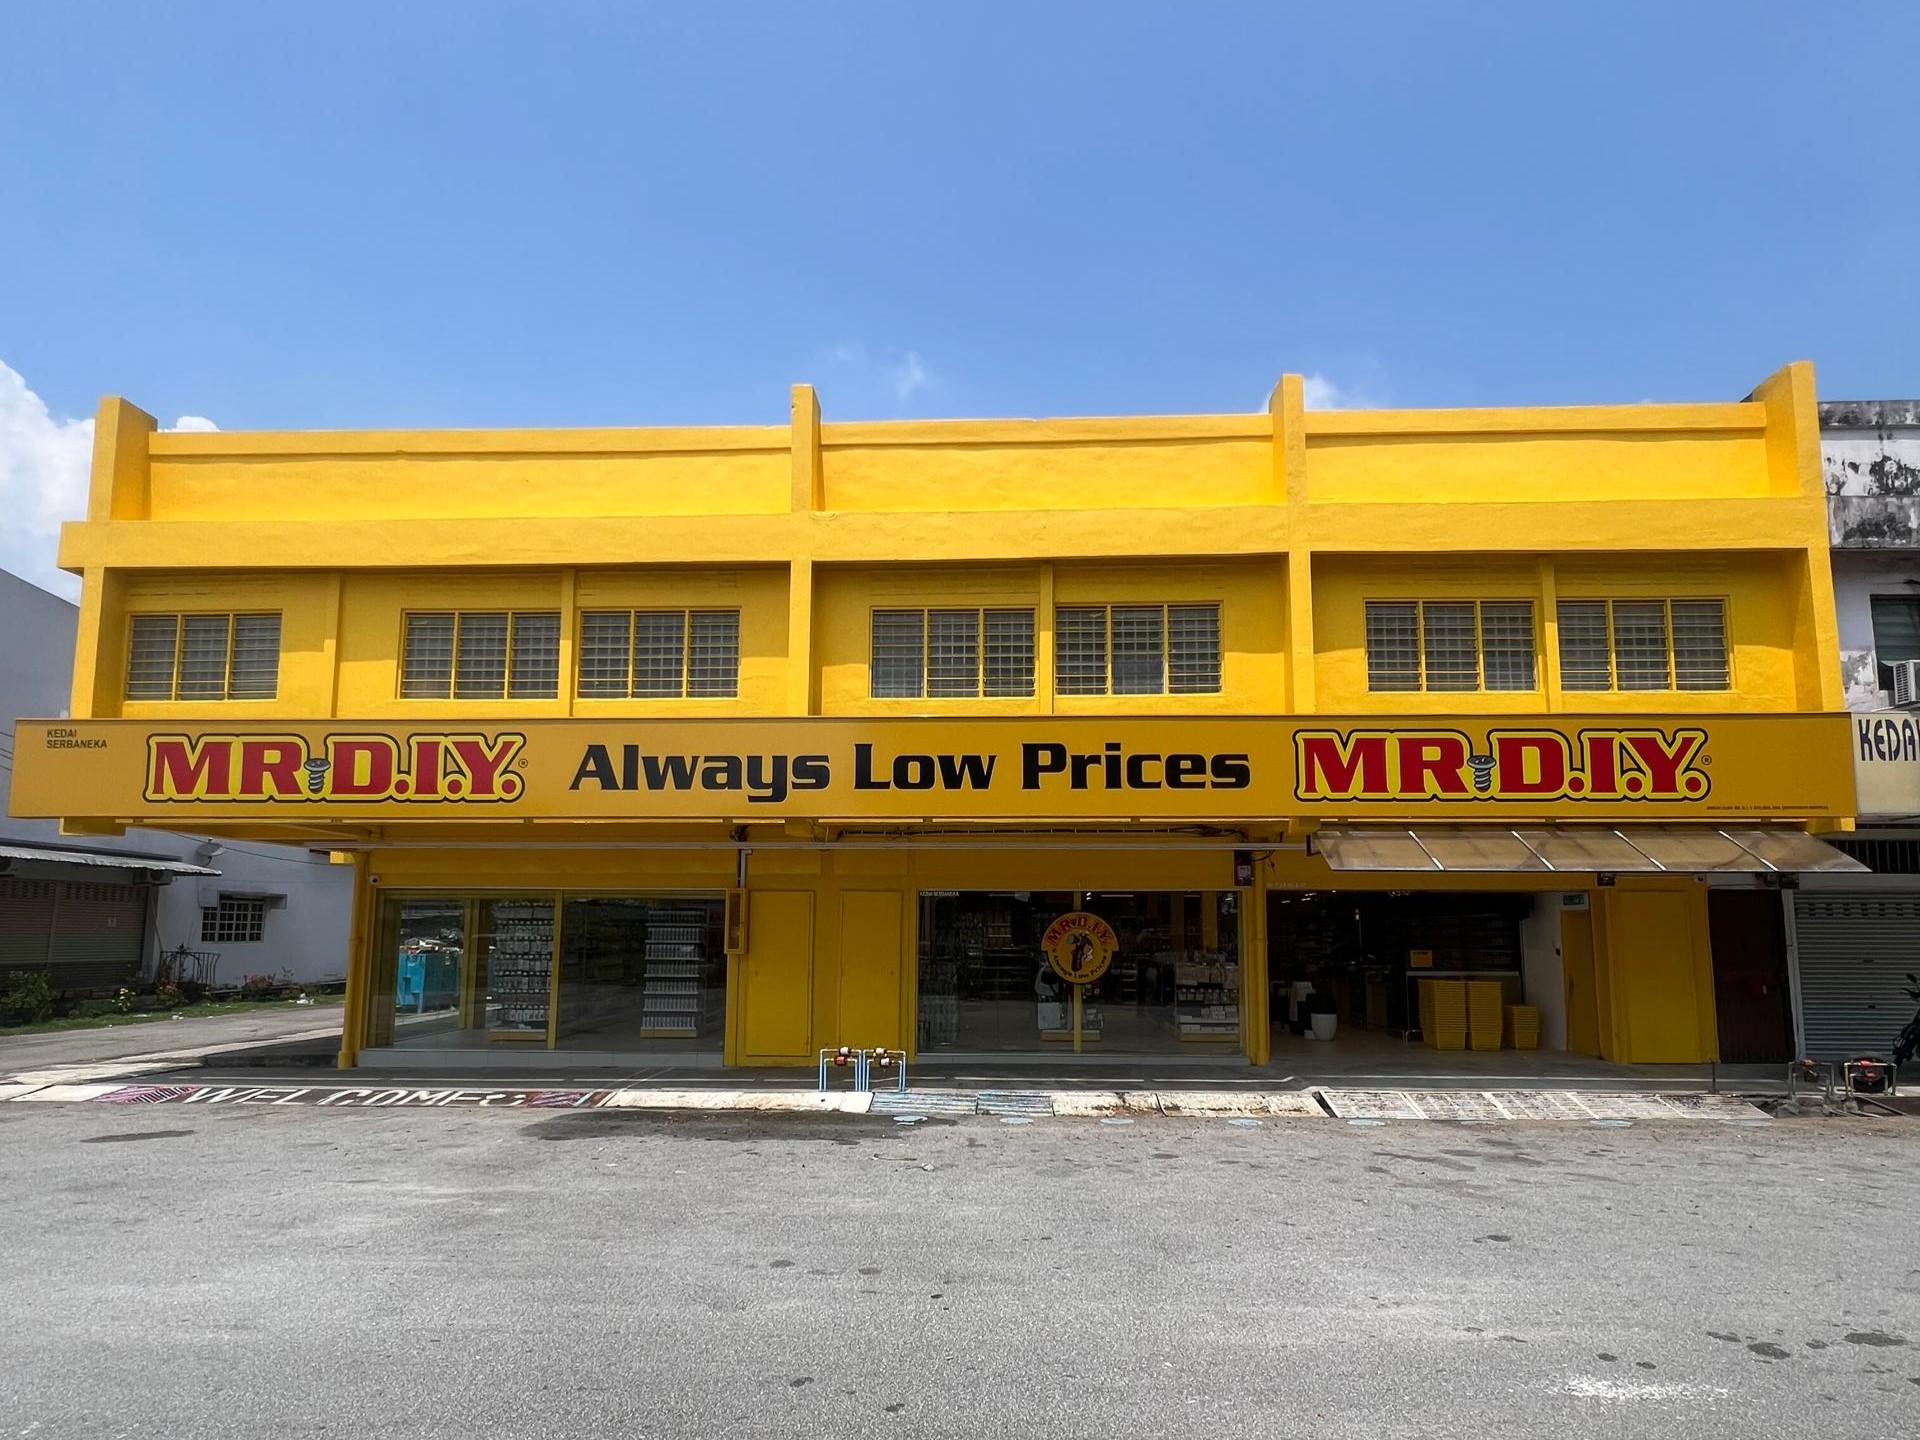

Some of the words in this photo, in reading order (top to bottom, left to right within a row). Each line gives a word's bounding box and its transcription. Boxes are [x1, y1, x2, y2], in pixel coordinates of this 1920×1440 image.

[47, 729, 77, 739] KEDAI
[46, 739, 108, 749] SERBANEKA
[569, 743, 830, 803] Always
[854, 743, 997, 791] Low
[1021, 742, 1250, 790] Prices
